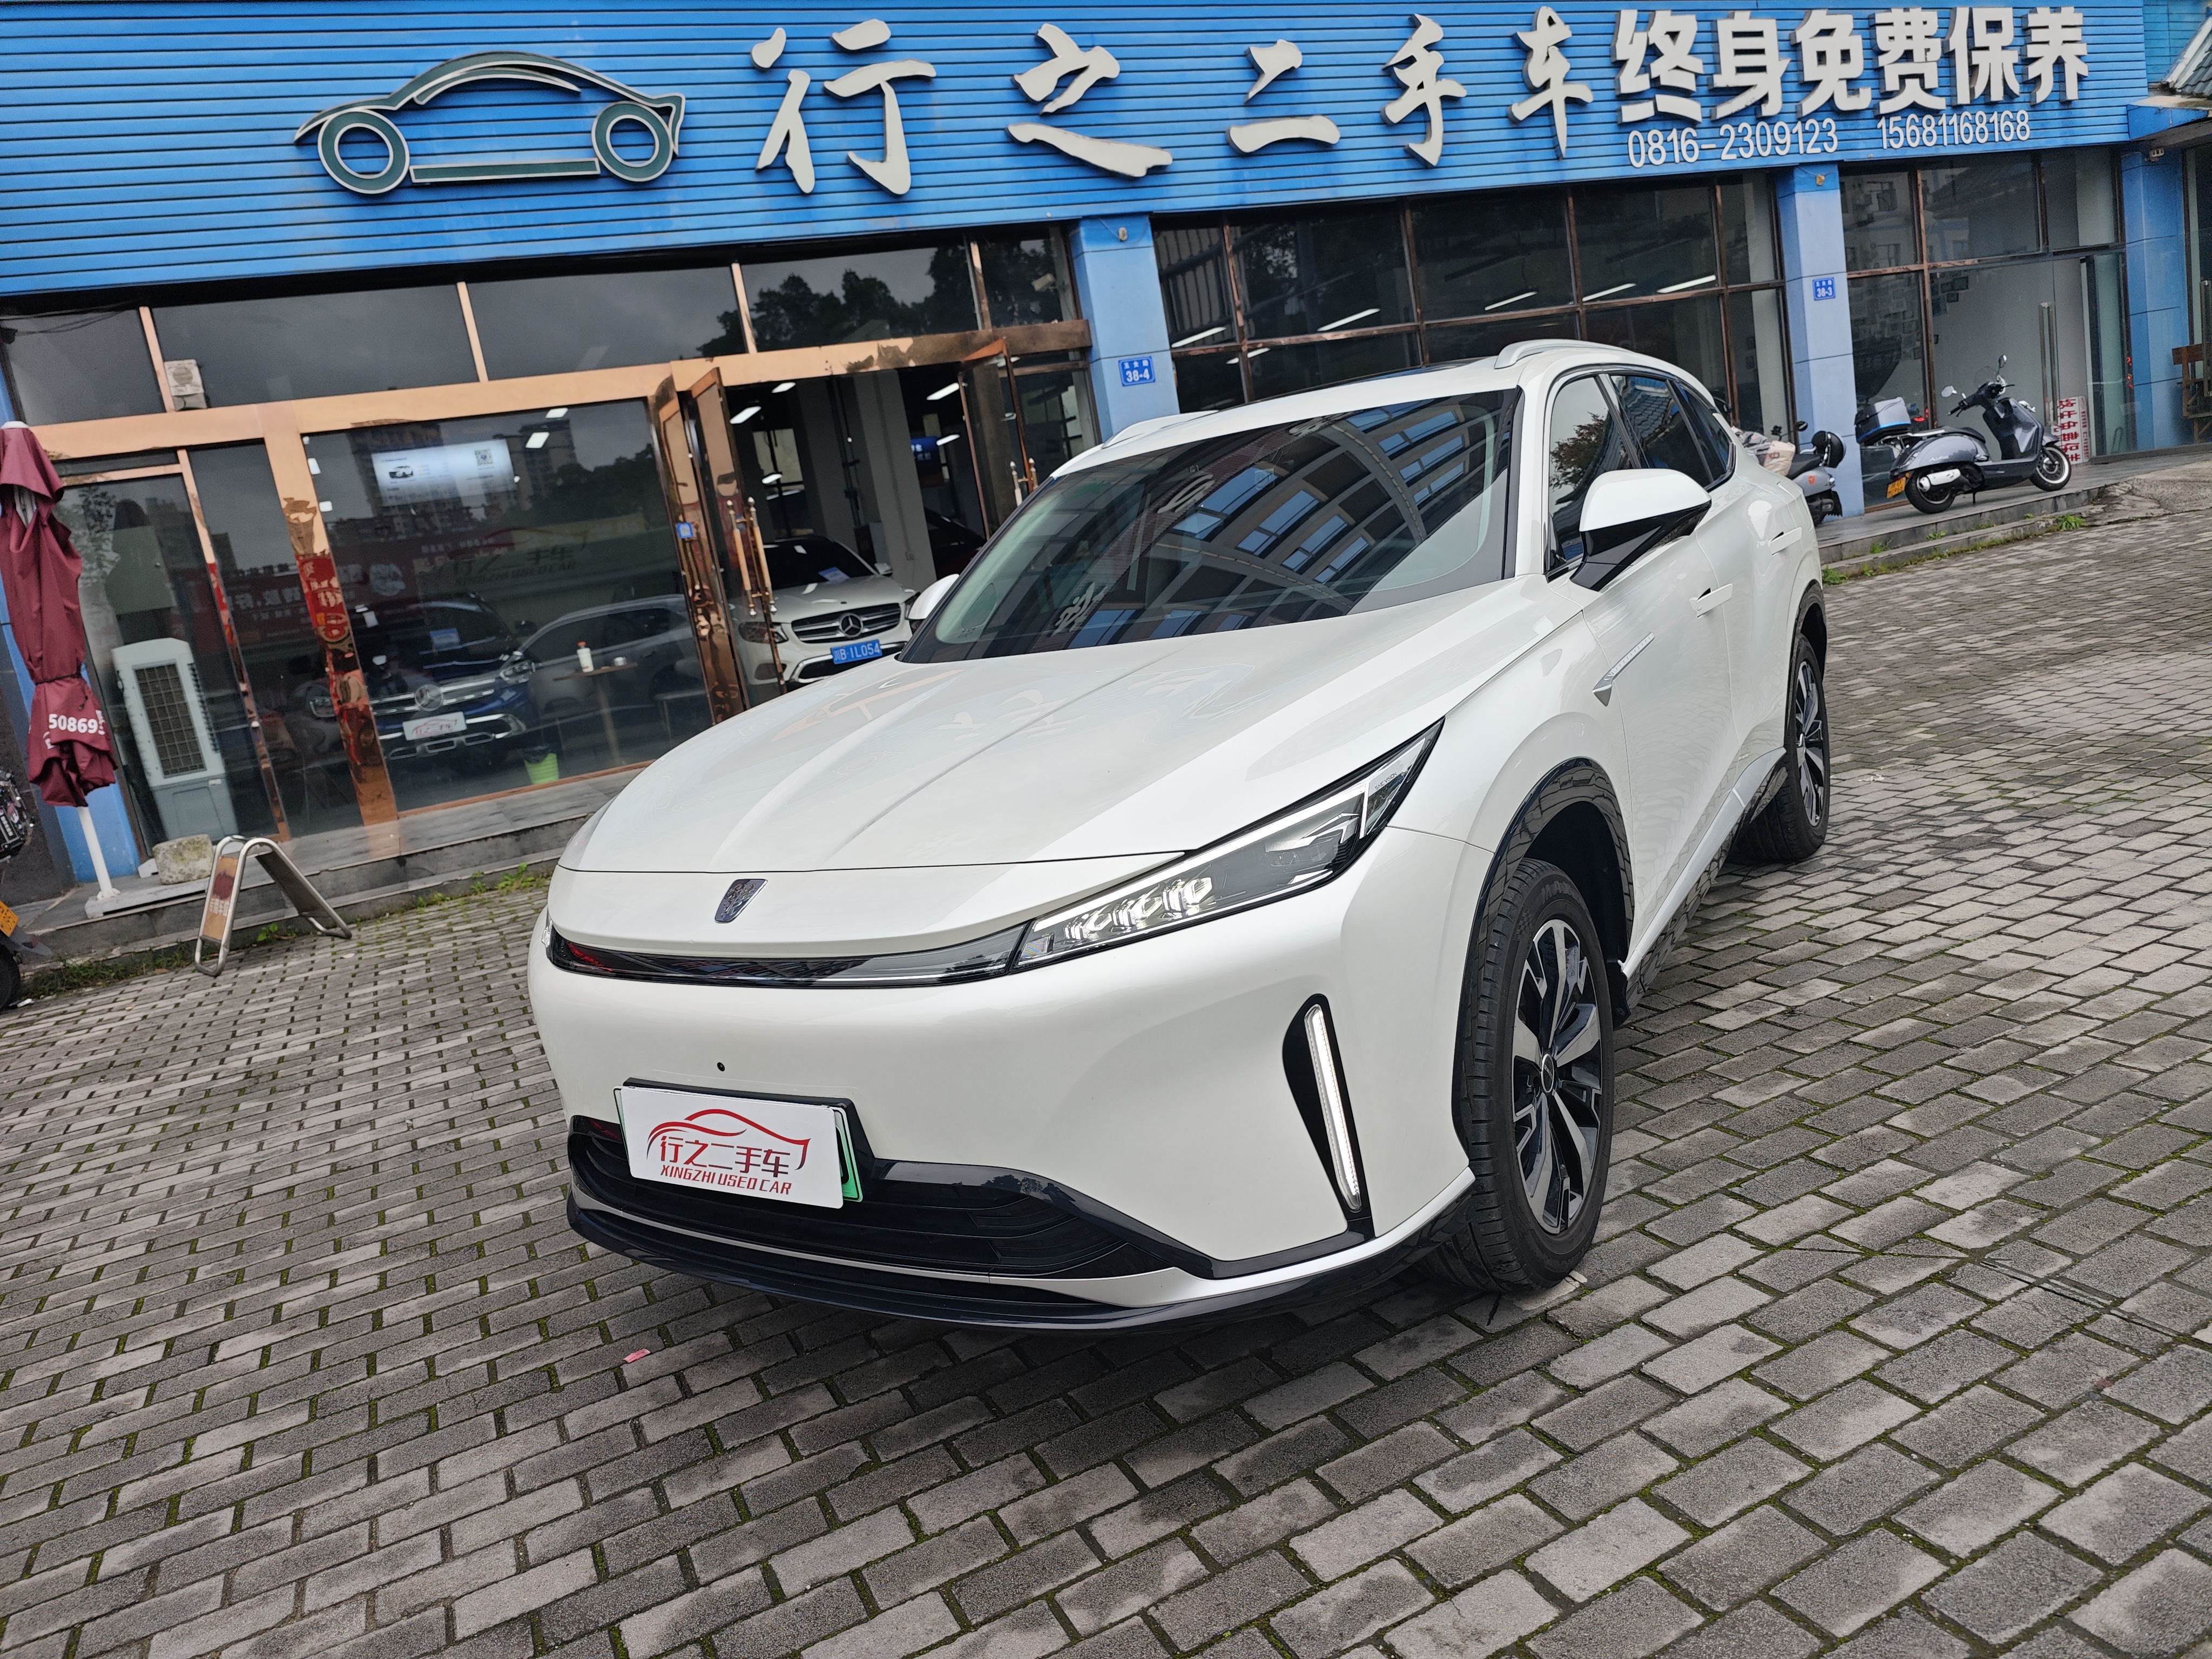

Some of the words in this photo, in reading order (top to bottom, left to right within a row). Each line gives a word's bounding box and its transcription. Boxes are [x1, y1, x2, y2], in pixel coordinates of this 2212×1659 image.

[1610, 5, 2089, 124] 终身免费保养
[749, 5, 1594, 196] 行之二手车
[1627, 117, 1838, 170] 0816-2309123
[1877, 109, 2031, 151] 15681168168
[1817, 286, 1833, 298] 38-3
[1125, 368, 1150, 382] 38-4
[660, 1136, 791, 1177] 行之二手车
[660, 1164, 716, 1184] XINGZHI
[717, 1174, 758, 1191] USED
[759, 1178, 792, 1195] CAR
